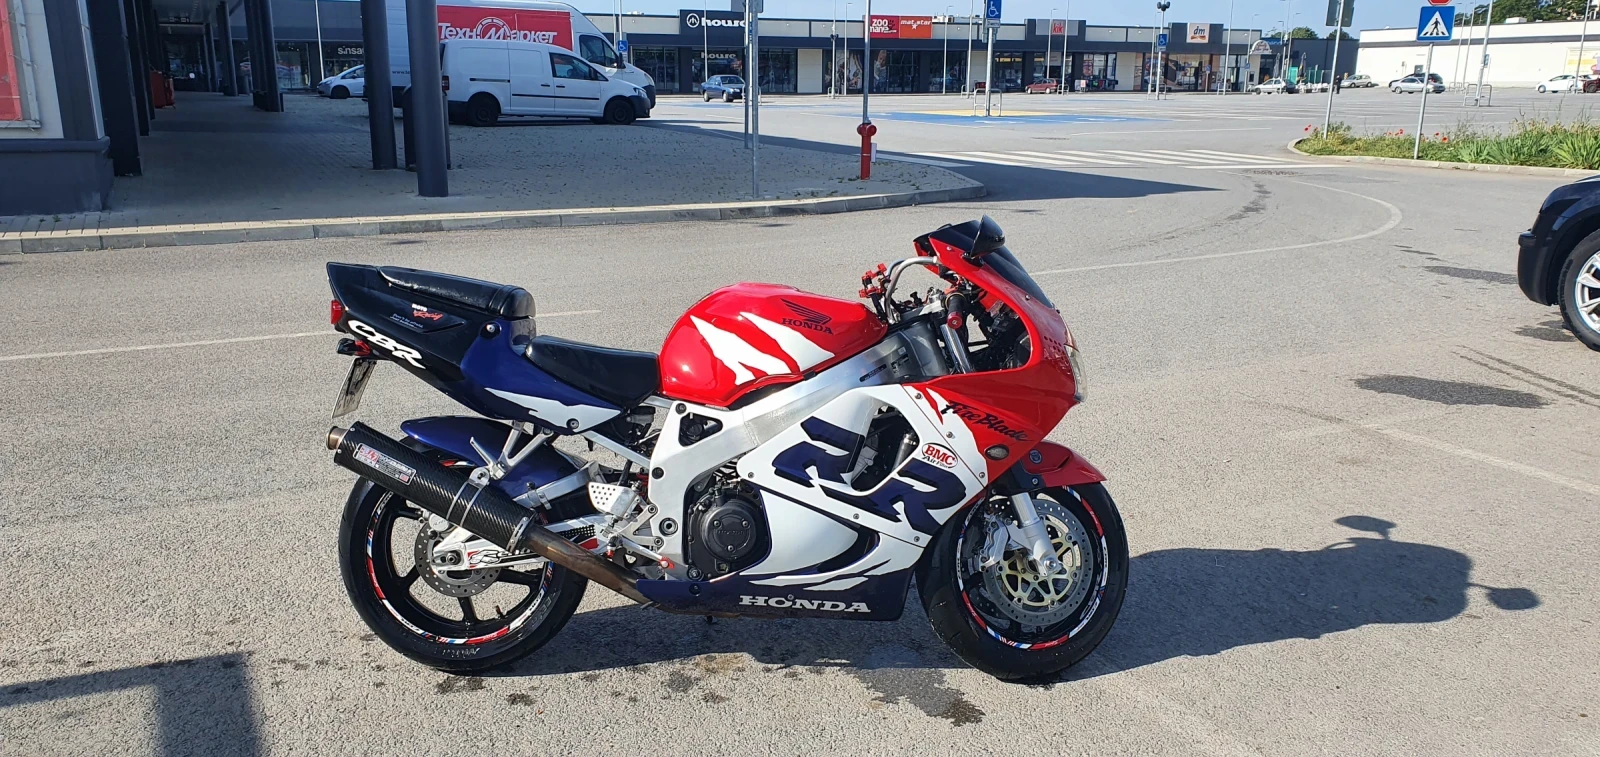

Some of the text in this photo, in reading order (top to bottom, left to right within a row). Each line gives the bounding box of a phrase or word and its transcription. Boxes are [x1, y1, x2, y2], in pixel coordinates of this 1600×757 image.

[1193, 26, 1206, 35] dm
[781, 317, 833, 335] HONDA
[347, 319, 426, 370] CBR
[925, 444, 956, 466] BMC
[738, 594, 872, 613] HONDA
